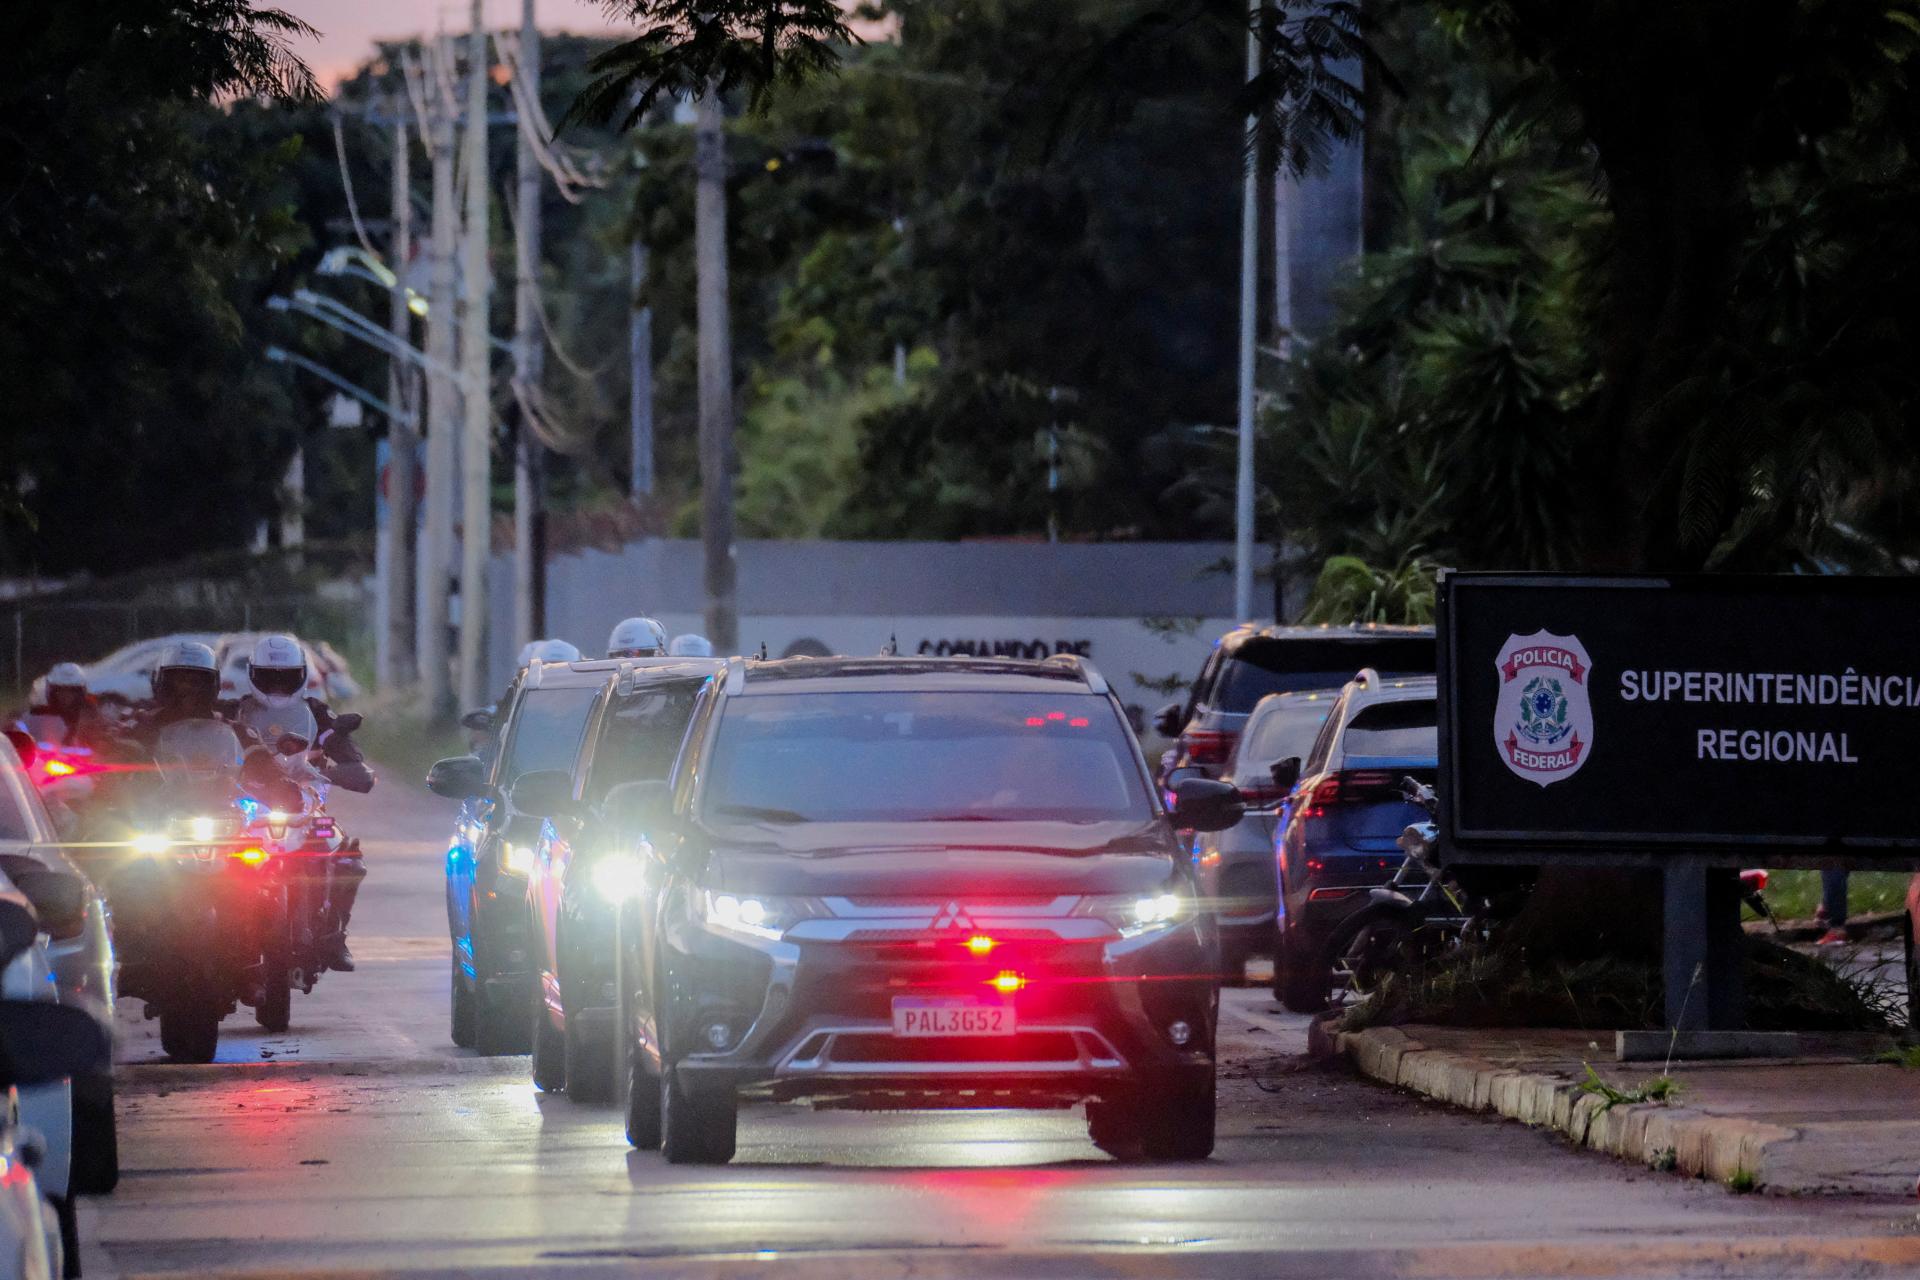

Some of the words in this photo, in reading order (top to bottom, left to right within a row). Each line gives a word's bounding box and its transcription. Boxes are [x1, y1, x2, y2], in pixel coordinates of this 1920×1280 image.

[1697, 729, 1858, 763] REGIONAL
[1513, 749, 1573, 769] FEDERAL
[905, 1010, 1003, 1033] PAL3G52
